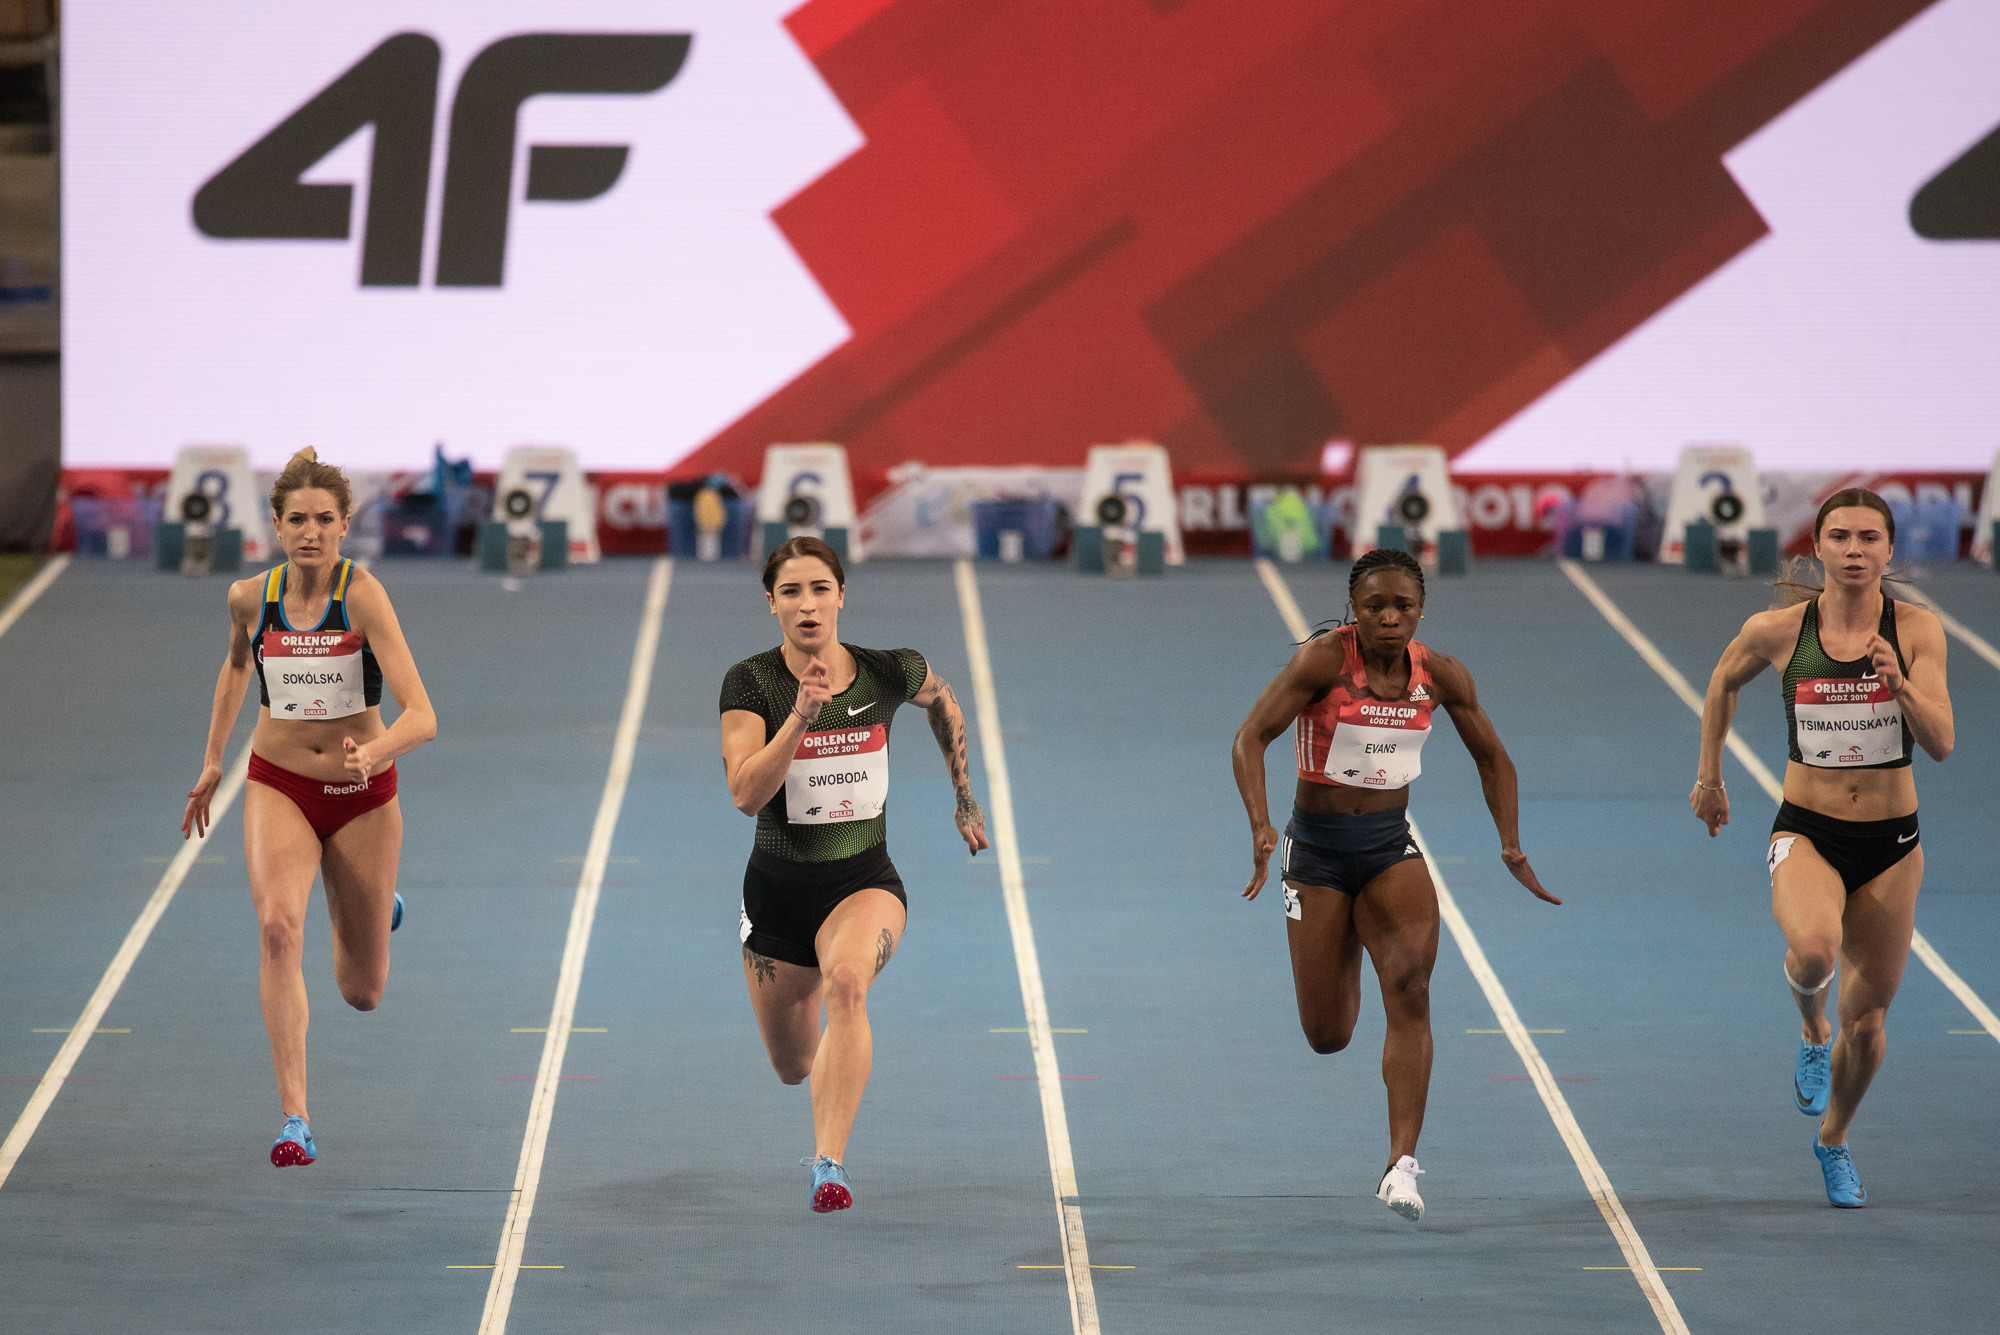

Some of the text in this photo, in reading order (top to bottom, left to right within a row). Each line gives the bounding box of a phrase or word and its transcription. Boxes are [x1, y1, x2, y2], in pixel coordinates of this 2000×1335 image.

[190, 30, 694, 288] 4F
[1113, 472, 1146, 529] 5
[604, 484, 668, 530] CU
[281, 635, 342, 646] ORLEN CUP
[292, 647, 313, 655] ŁÓDŹ
[283, 671, 344, 684] SOKÓLSKA
[1814, 682, 1881, 693] ORLEN CUP
[1409, 694, 1430, 702] adidas
[1826, 694, 1849, 702] ŁÓDŹ
[284, 703, 297, 712] 4F
[1360, 705, 1417, 719] ORLEN CUP
[1370, 717, 1406, 726] ŁÓDŹ 2019
[1800, 715, 1898, 731] TSIMANOUSKAYA
[803, 731, 871, 748] ORLEN CUP
[817, 744, 859, 755] ŁÓDŹ 2019
[1365, 743, 1397, 754] EVANS
[1816, 750, 1832, 759] 4F
[808, 770, 868, 787] SWOBODA
[1343, 769, 1360, 778] 4F
[806, 806, 822, 816] 4F
[830, 810, 853, 818] ORLEN
